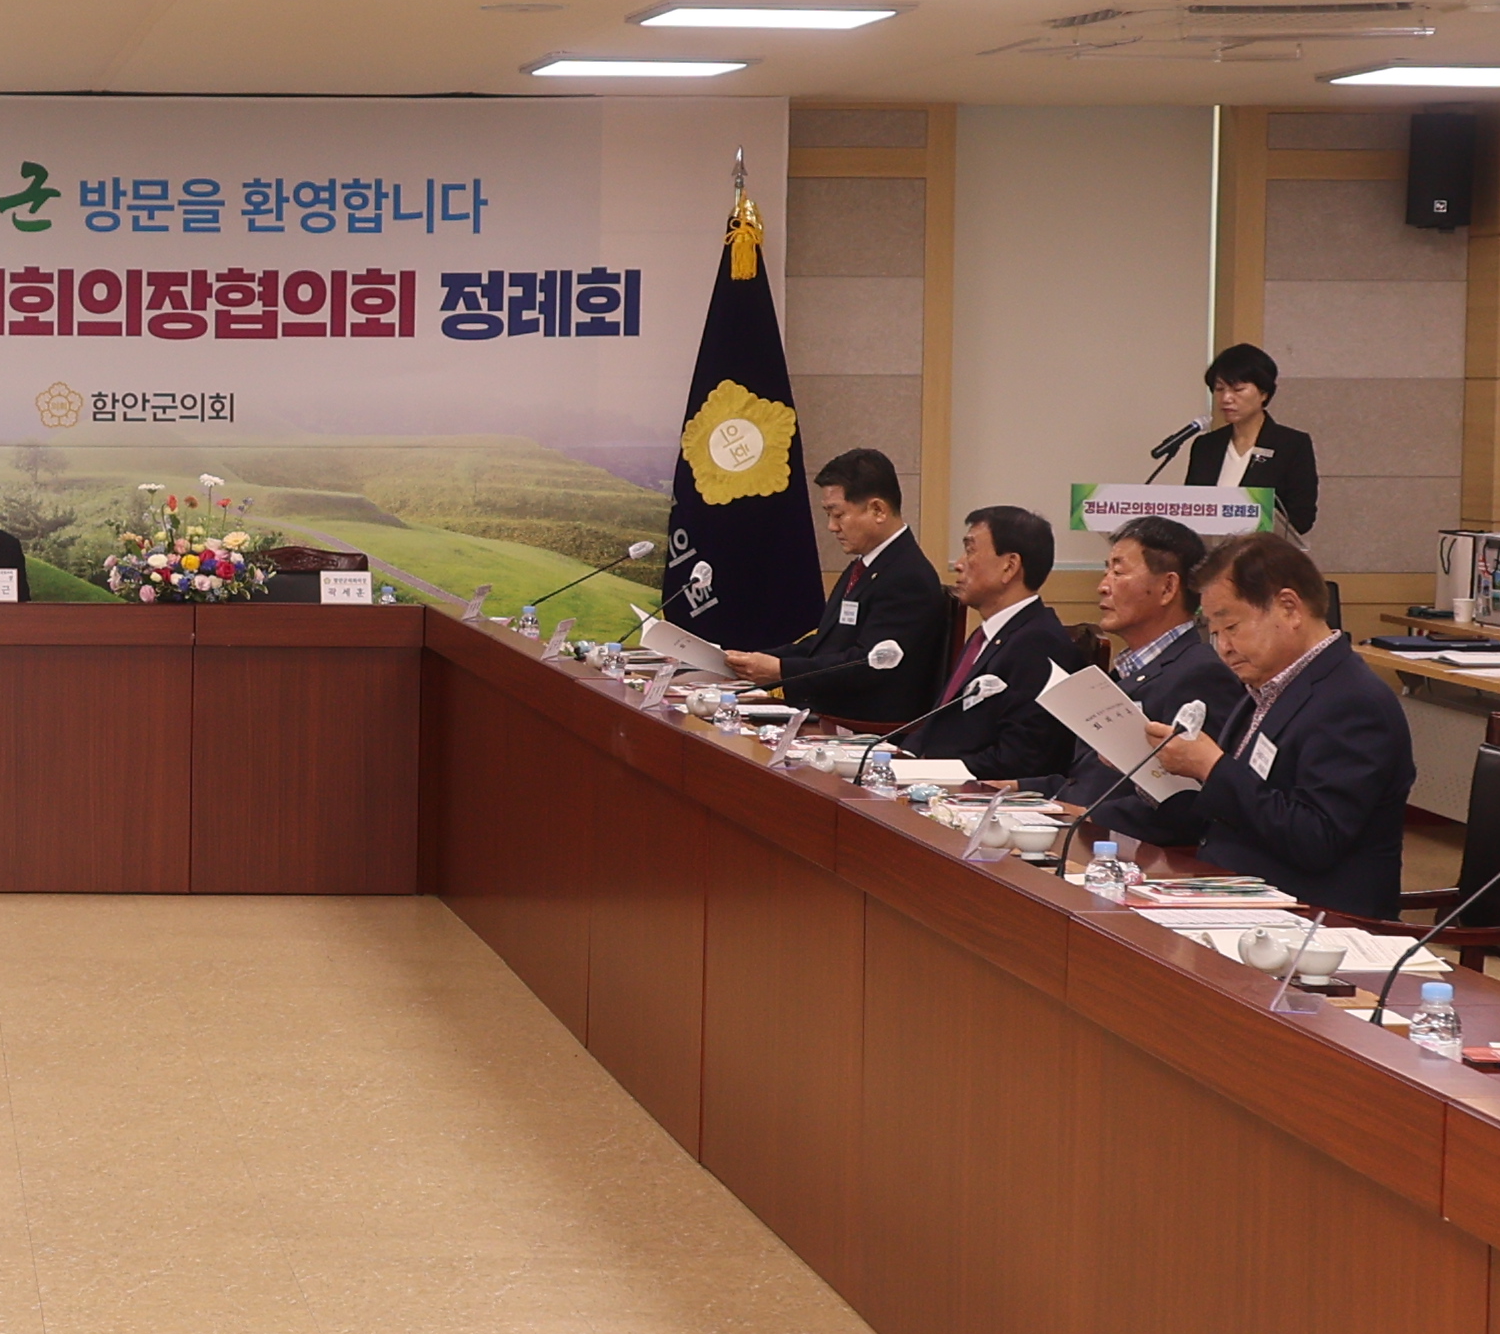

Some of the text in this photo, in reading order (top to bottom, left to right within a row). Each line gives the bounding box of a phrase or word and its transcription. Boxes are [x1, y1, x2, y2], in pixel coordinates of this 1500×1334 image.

[79, 176, 226, 233] 방문을
[240, 177, 489, 234] 환영합니다
[440, 267, 641, 341] 정례회
[91, 391, 235, 423] 함안군의회
[1083, 501, 1260, 518] 경남시군의회의장협의회 정례회
